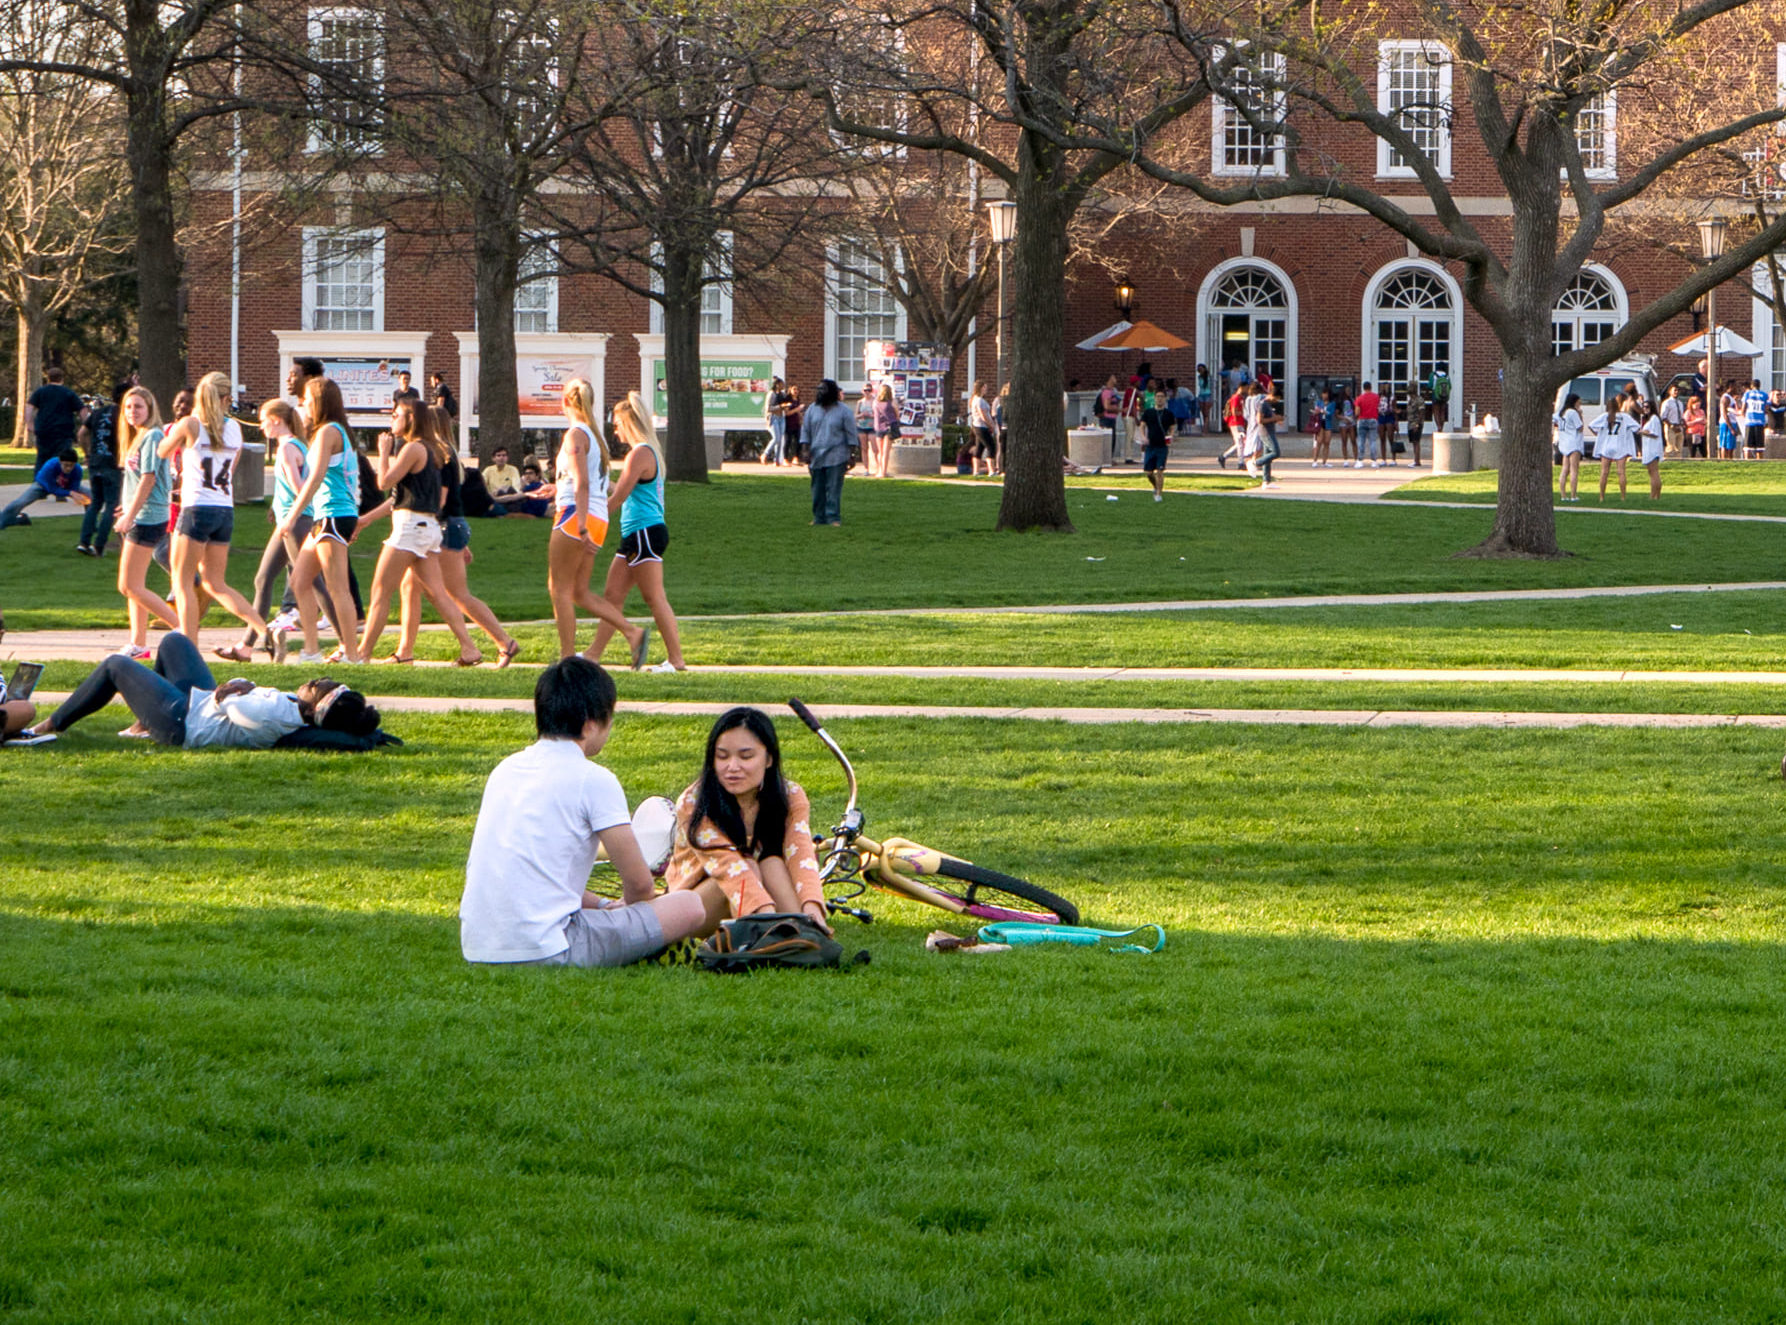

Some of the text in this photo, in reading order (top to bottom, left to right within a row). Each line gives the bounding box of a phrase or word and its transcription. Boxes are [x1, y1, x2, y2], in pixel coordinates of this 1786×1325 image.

[710, 366, 726, 377] FOR
[727, 366, 754, 377] FOOD?
[201, 456, 232, 496] 14
